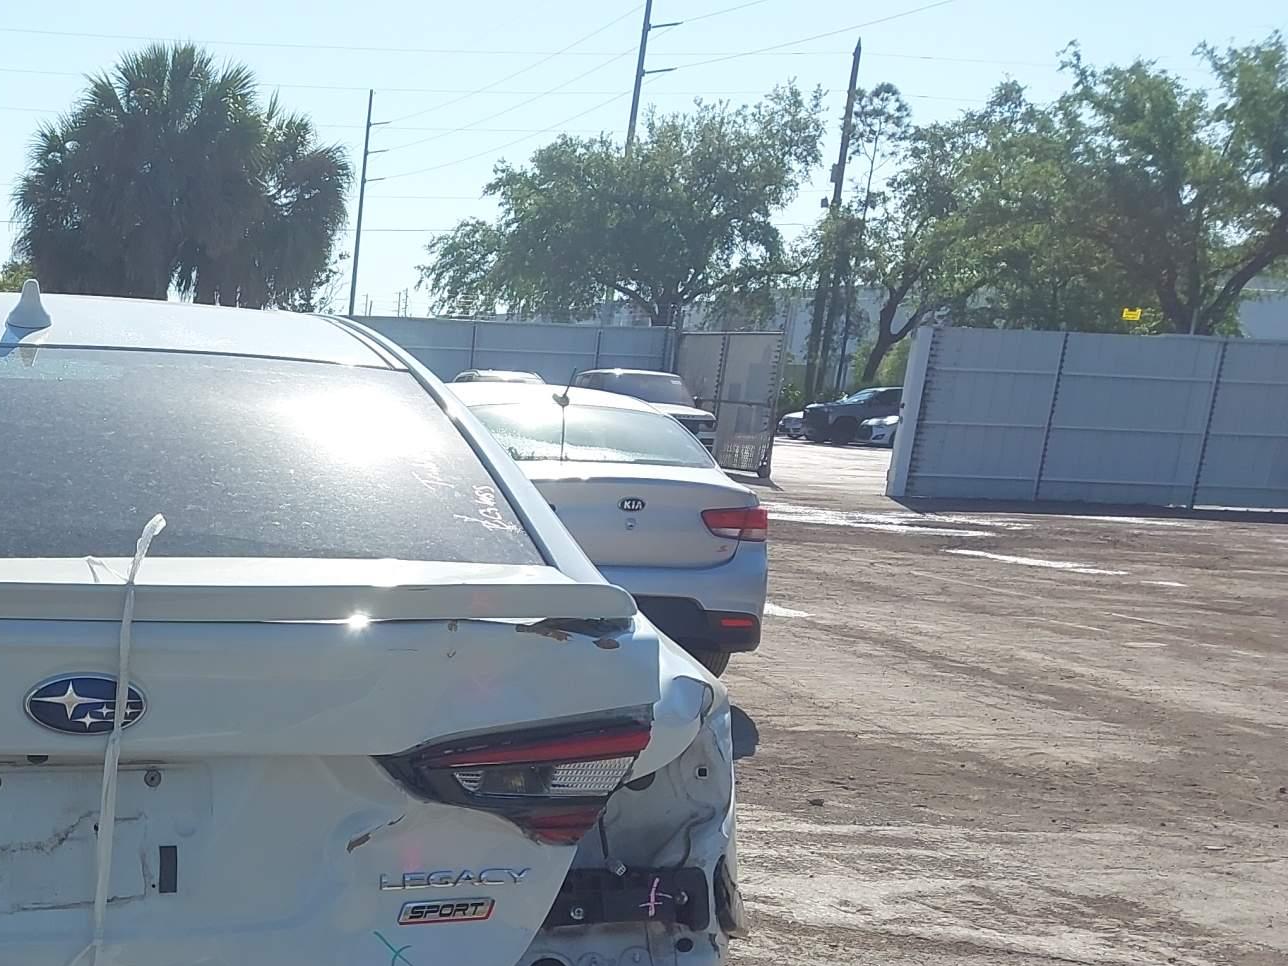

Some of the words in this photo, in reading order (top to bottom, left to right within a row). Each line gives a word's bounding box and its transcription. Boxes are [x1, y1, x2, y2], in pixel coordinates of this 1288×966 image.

[623, 500, 642, 510] KIA
[379, 867, 531, 890] LEGACY
[409, 902, 485, 920] SPORT
